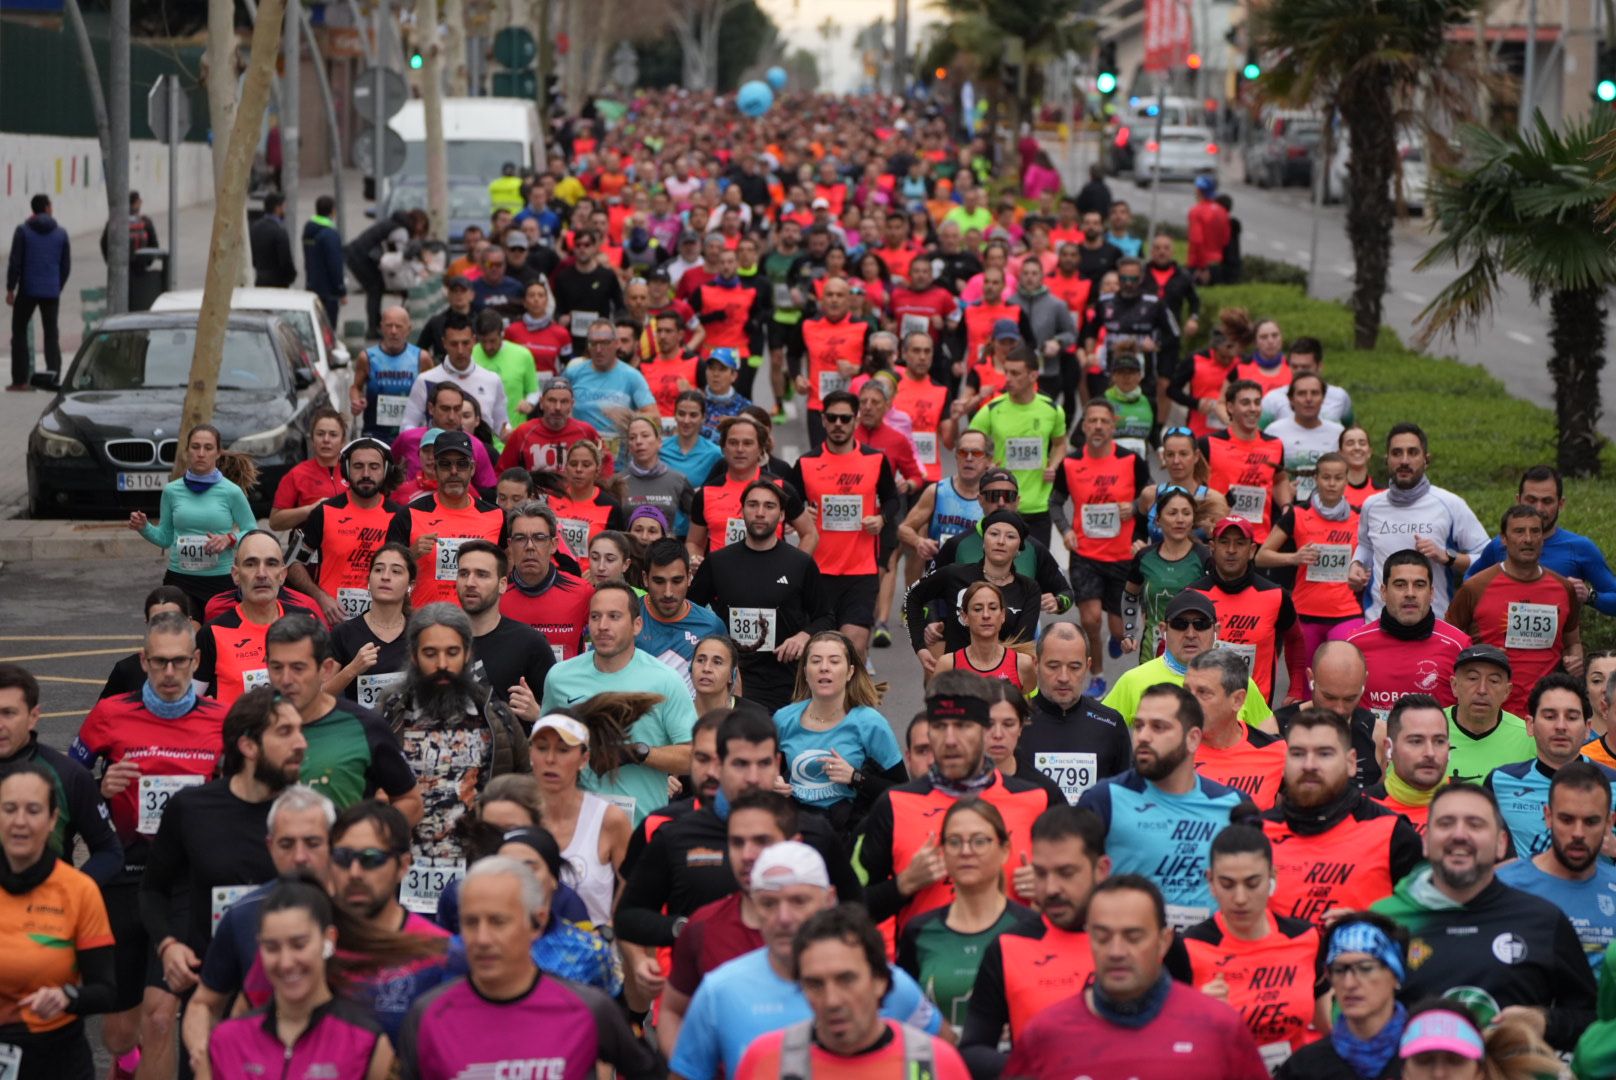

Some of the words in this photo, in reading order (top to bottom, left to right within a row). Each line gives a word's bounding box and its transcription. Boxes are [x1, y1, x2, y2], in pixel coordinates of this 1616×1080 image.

[1010, 446, 1038, 457] 3184
[126, 473, 162, 488] 6104
[836, 473, 864, 485] RUN
[1093, 475, 1118, 487] RUN
[1233, 494, 1260, 508] 581
[826, 504, 858, 517] 2993
[1086, 513, 1115, 525] 3727
[357, 527, 386, 542] RUN
[1380, 521, 1433, 534] ASCIRES
[1326, 530, 1353, 544] RUN
[1225, 615, 1261, 630] RUN
[1512, 615, 1552, 632] 3153
[1171, 819, 1217, 841] RUN
[1154, 855, 1205, 877] LIFE
[1304, 862, 1355, 885] RUN
[1307, 886, 1332, 898] FOR
[1249, 966, 1297, 991] RUN
